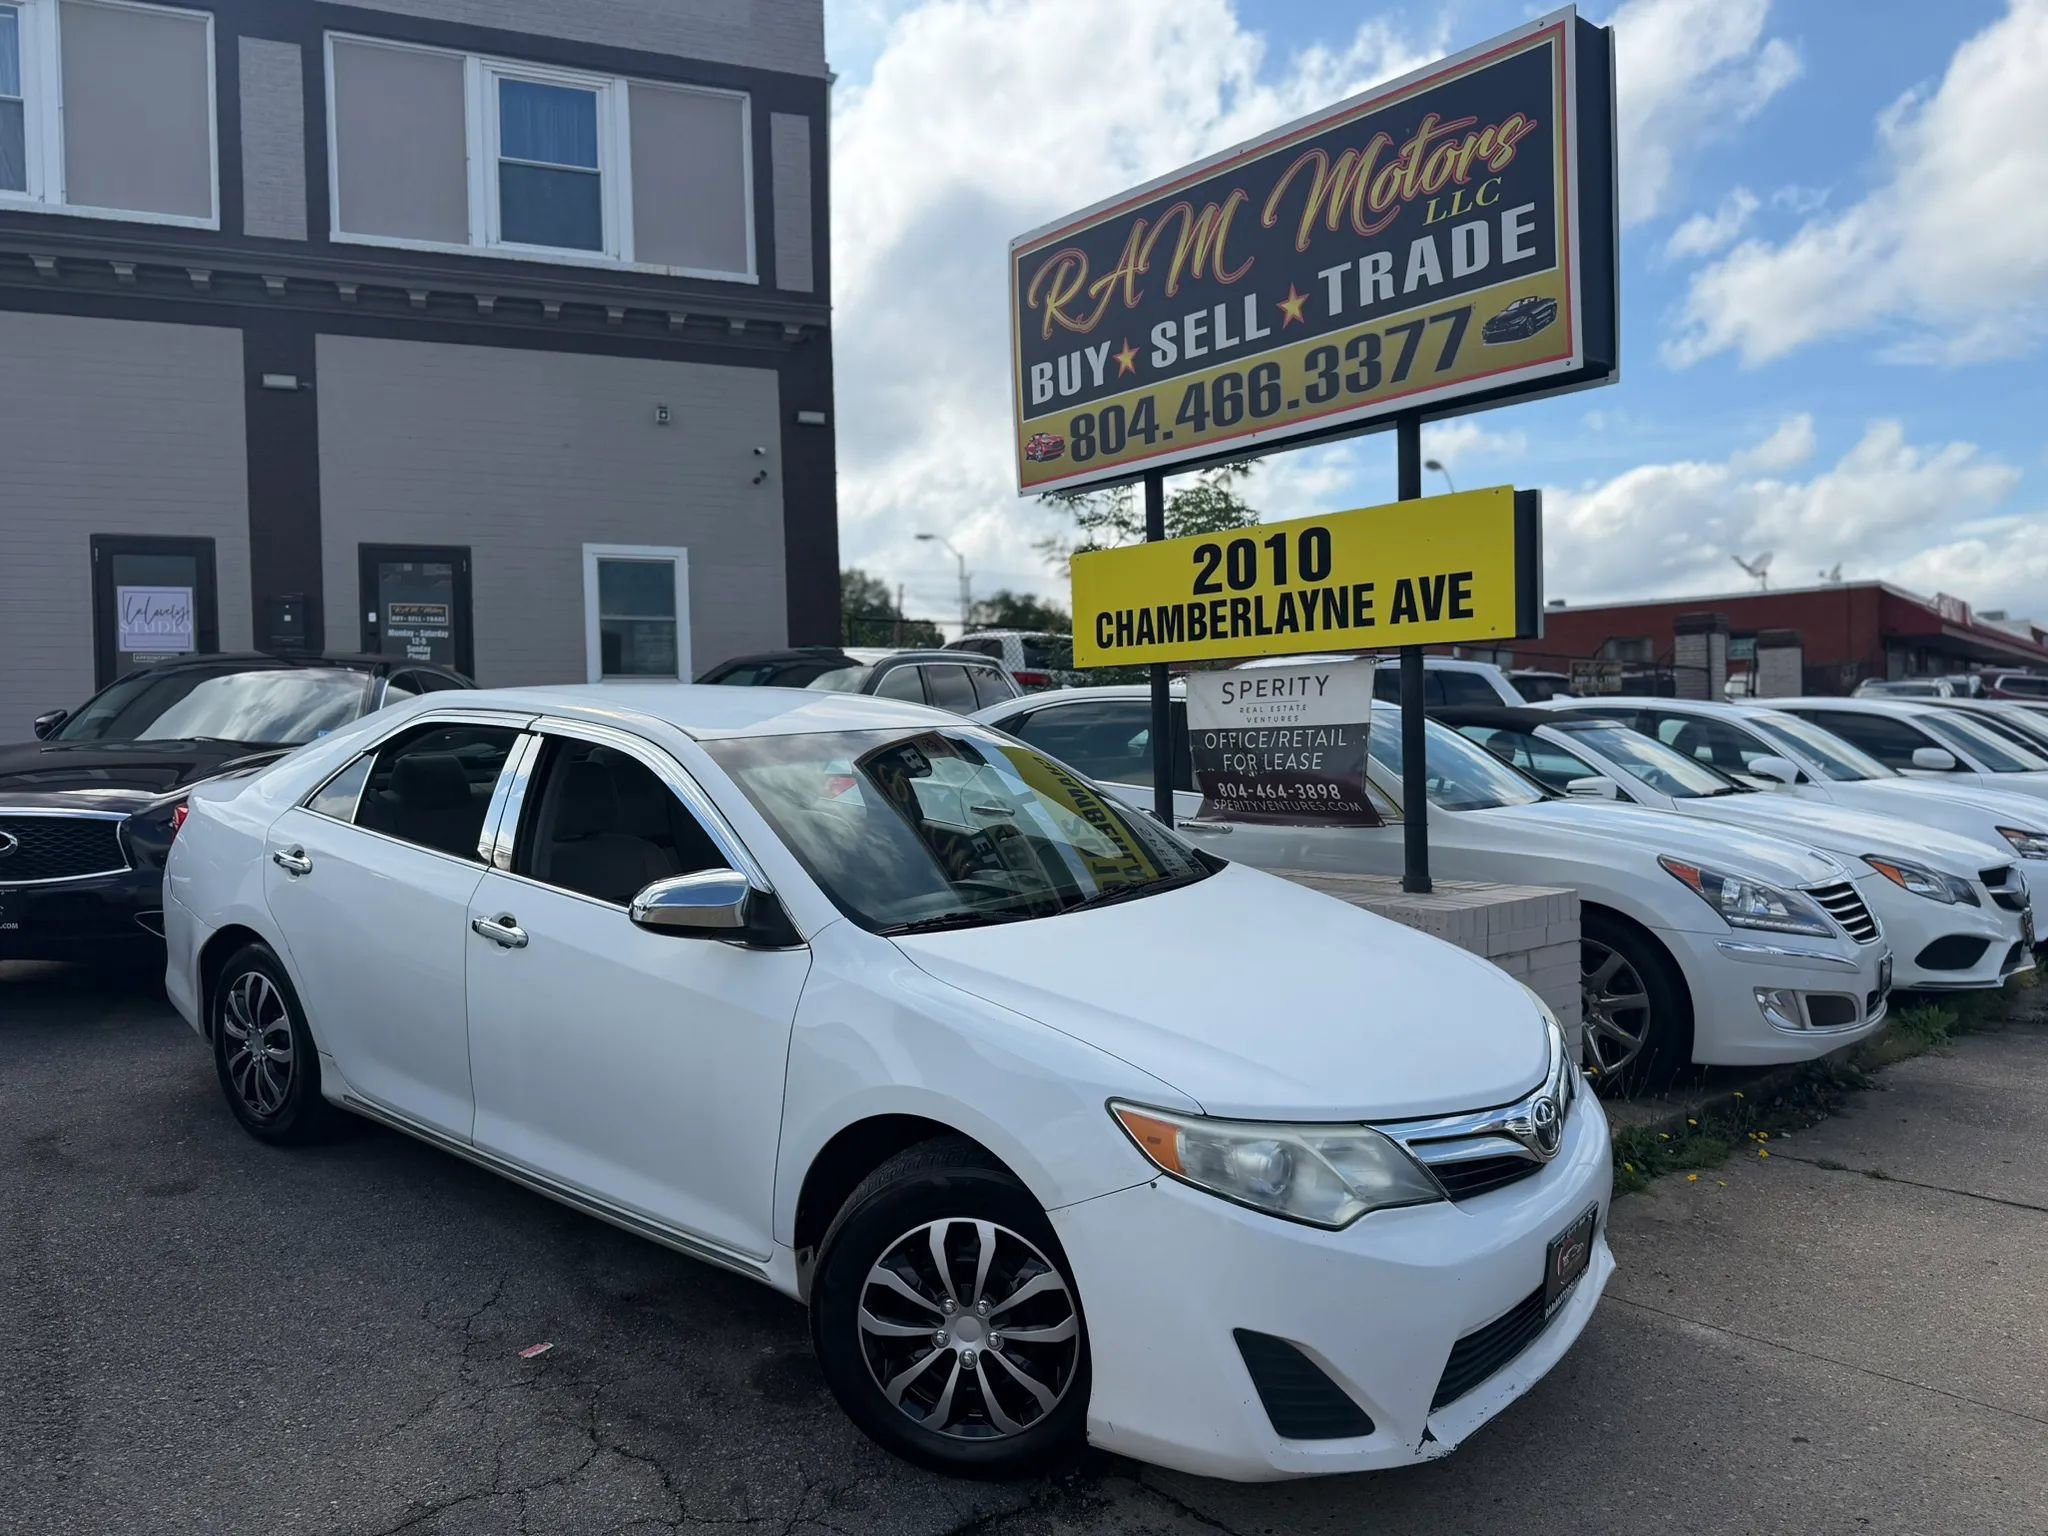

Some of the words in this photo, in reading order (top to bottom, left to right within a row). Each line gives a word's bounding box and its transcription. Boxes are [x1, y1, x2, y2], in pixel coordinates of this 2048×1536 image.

[1422, 178, 1502, 227] LLC
[1027, 188, 1254, 340] RAM
[1261, 112, 1537, 251] Motors
[1030, 339, 1111, 406] BUY
[1150, 293, 1272, 368] SELL
[1318, 201, 1537, 317] TRADE
[1069, 305, 1476, 463] 804.466.3377
[1191, 526, 1332, 596] 2010
[1096, 582, 1376, 649] CHAMBERLAYNE
[1390, 571, 1474, 625] AVE
[1221, 674, 1331, 706] SPERITY
[1239, 706, 1264, 714] REAL
[1270, 704, 1308, 712] ESTATE
[1246, 715, 1300, 724] VENTURES
[1204, 728, 1348, 750] OFFICE/RETAIL
[1223, 753, 1258, 773] FOR
[1264, 752, 1325, 771] LEASE
[1212, 798, 1364, 812] SPERITYVENTURES.COM
[1217, 782, 1342, 800] 804-464-3898
